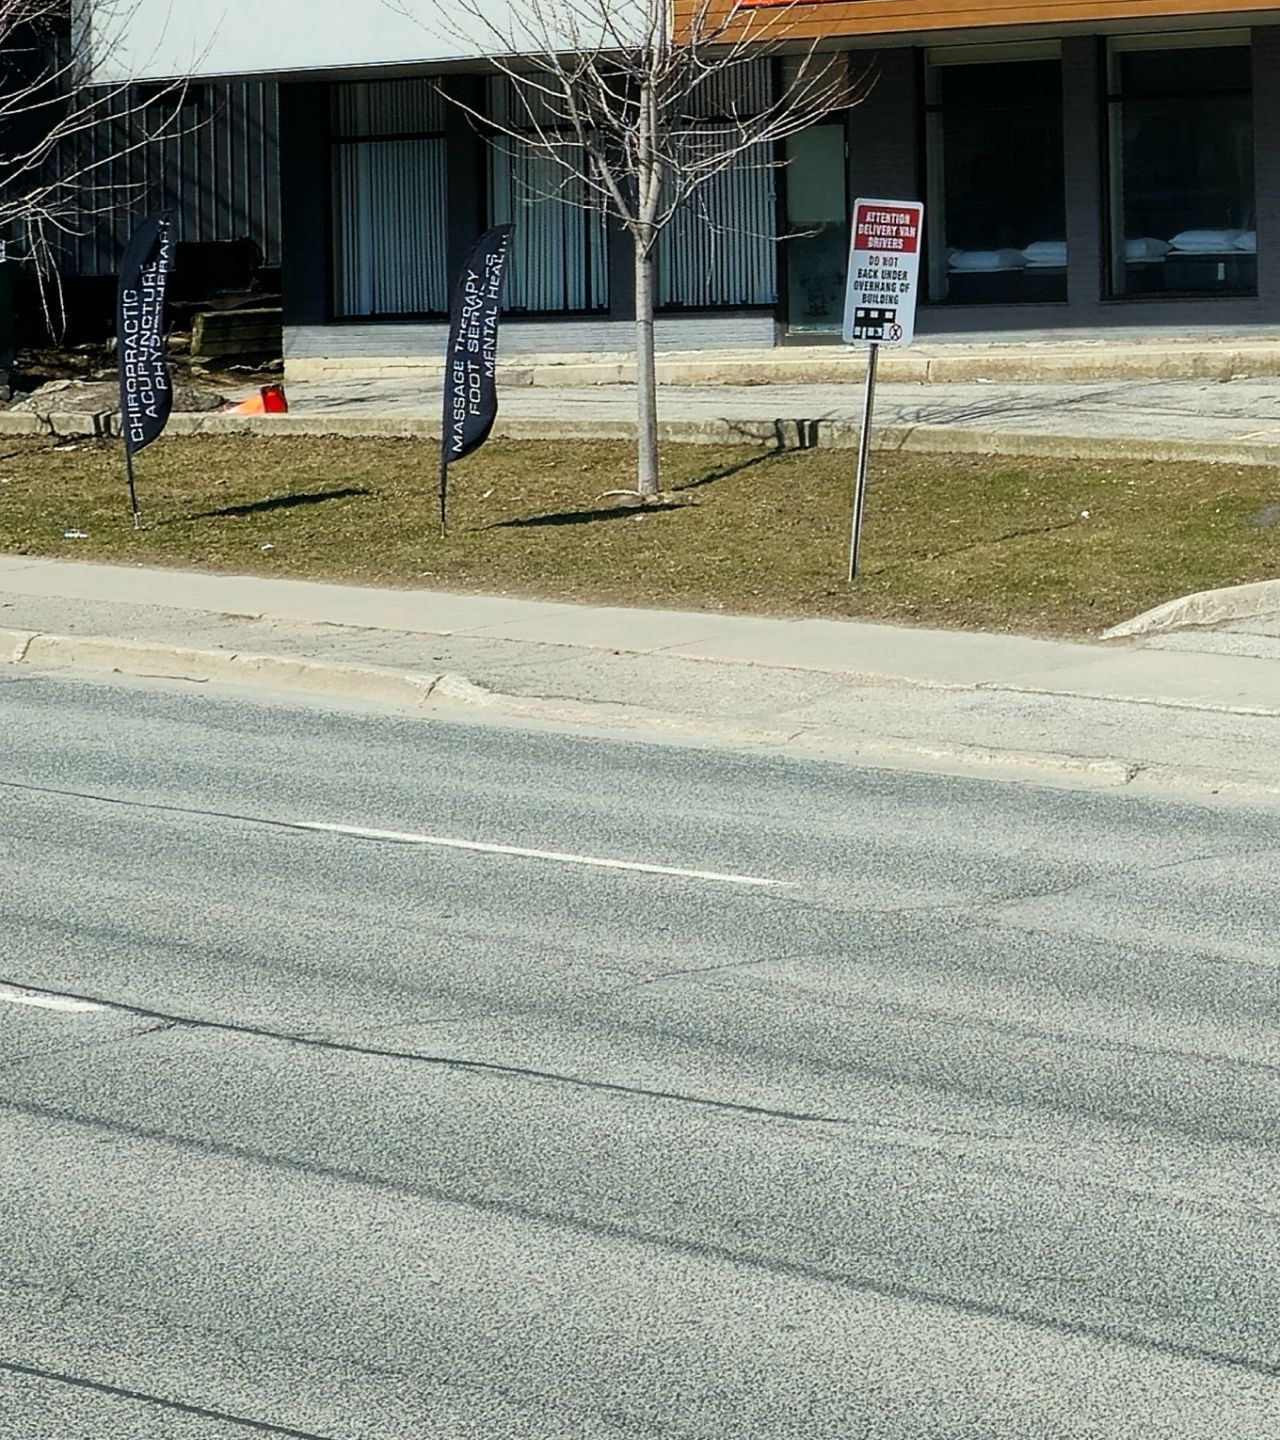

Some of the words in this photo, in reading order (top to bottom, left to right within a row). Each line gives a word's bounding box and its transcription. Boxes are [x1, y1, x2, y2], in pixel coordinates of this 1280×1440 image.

[866, 211, 910, 225] ATTENTION
[858, 223, 897, 237] DELIVERY
[900, 226, 916, 238] VAN
[868, 237, 903, 249] DRIVERS
[869, 255, 879, 266] DO
[882, 257, 899, 267] NOT
[858, 268, 878, 279] BACK
[881, 269, 908, 281] UNDER
[853, 280, 897, 293] OVERHANG
[899, 282, 911, 293] OF
[862, 293, 899, 305] BUILDING
[454, 269, 480, 353] THERAPY
[138, 262, 160, 418] ACUPUNCTURE
[482, 306, 498, 378] MENTAL
[123, 289, 144, 443] CHIROPRACTIC
[467, 362, 481, 415] FOOT
[452, 360, 466, 453] MASSAGE
